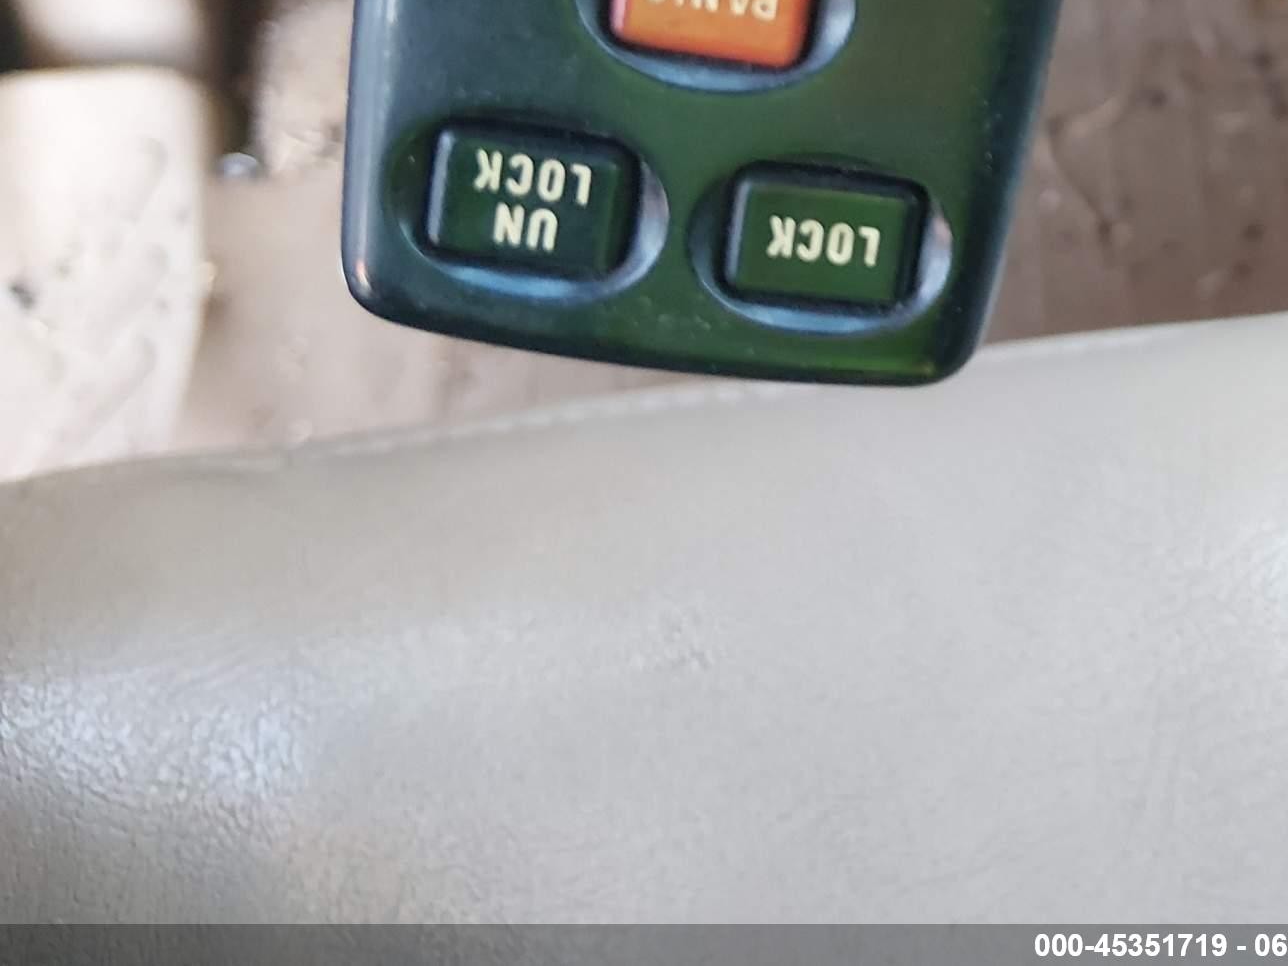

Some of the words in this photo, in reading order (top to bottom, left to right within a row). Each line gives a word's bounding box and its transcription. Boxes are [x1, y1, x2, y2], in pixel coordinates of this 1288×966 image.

[474, 149, 592, 206] LOCK
[493, 203, 559, 252] UN
[766, 215, 882, 267] LOCK
